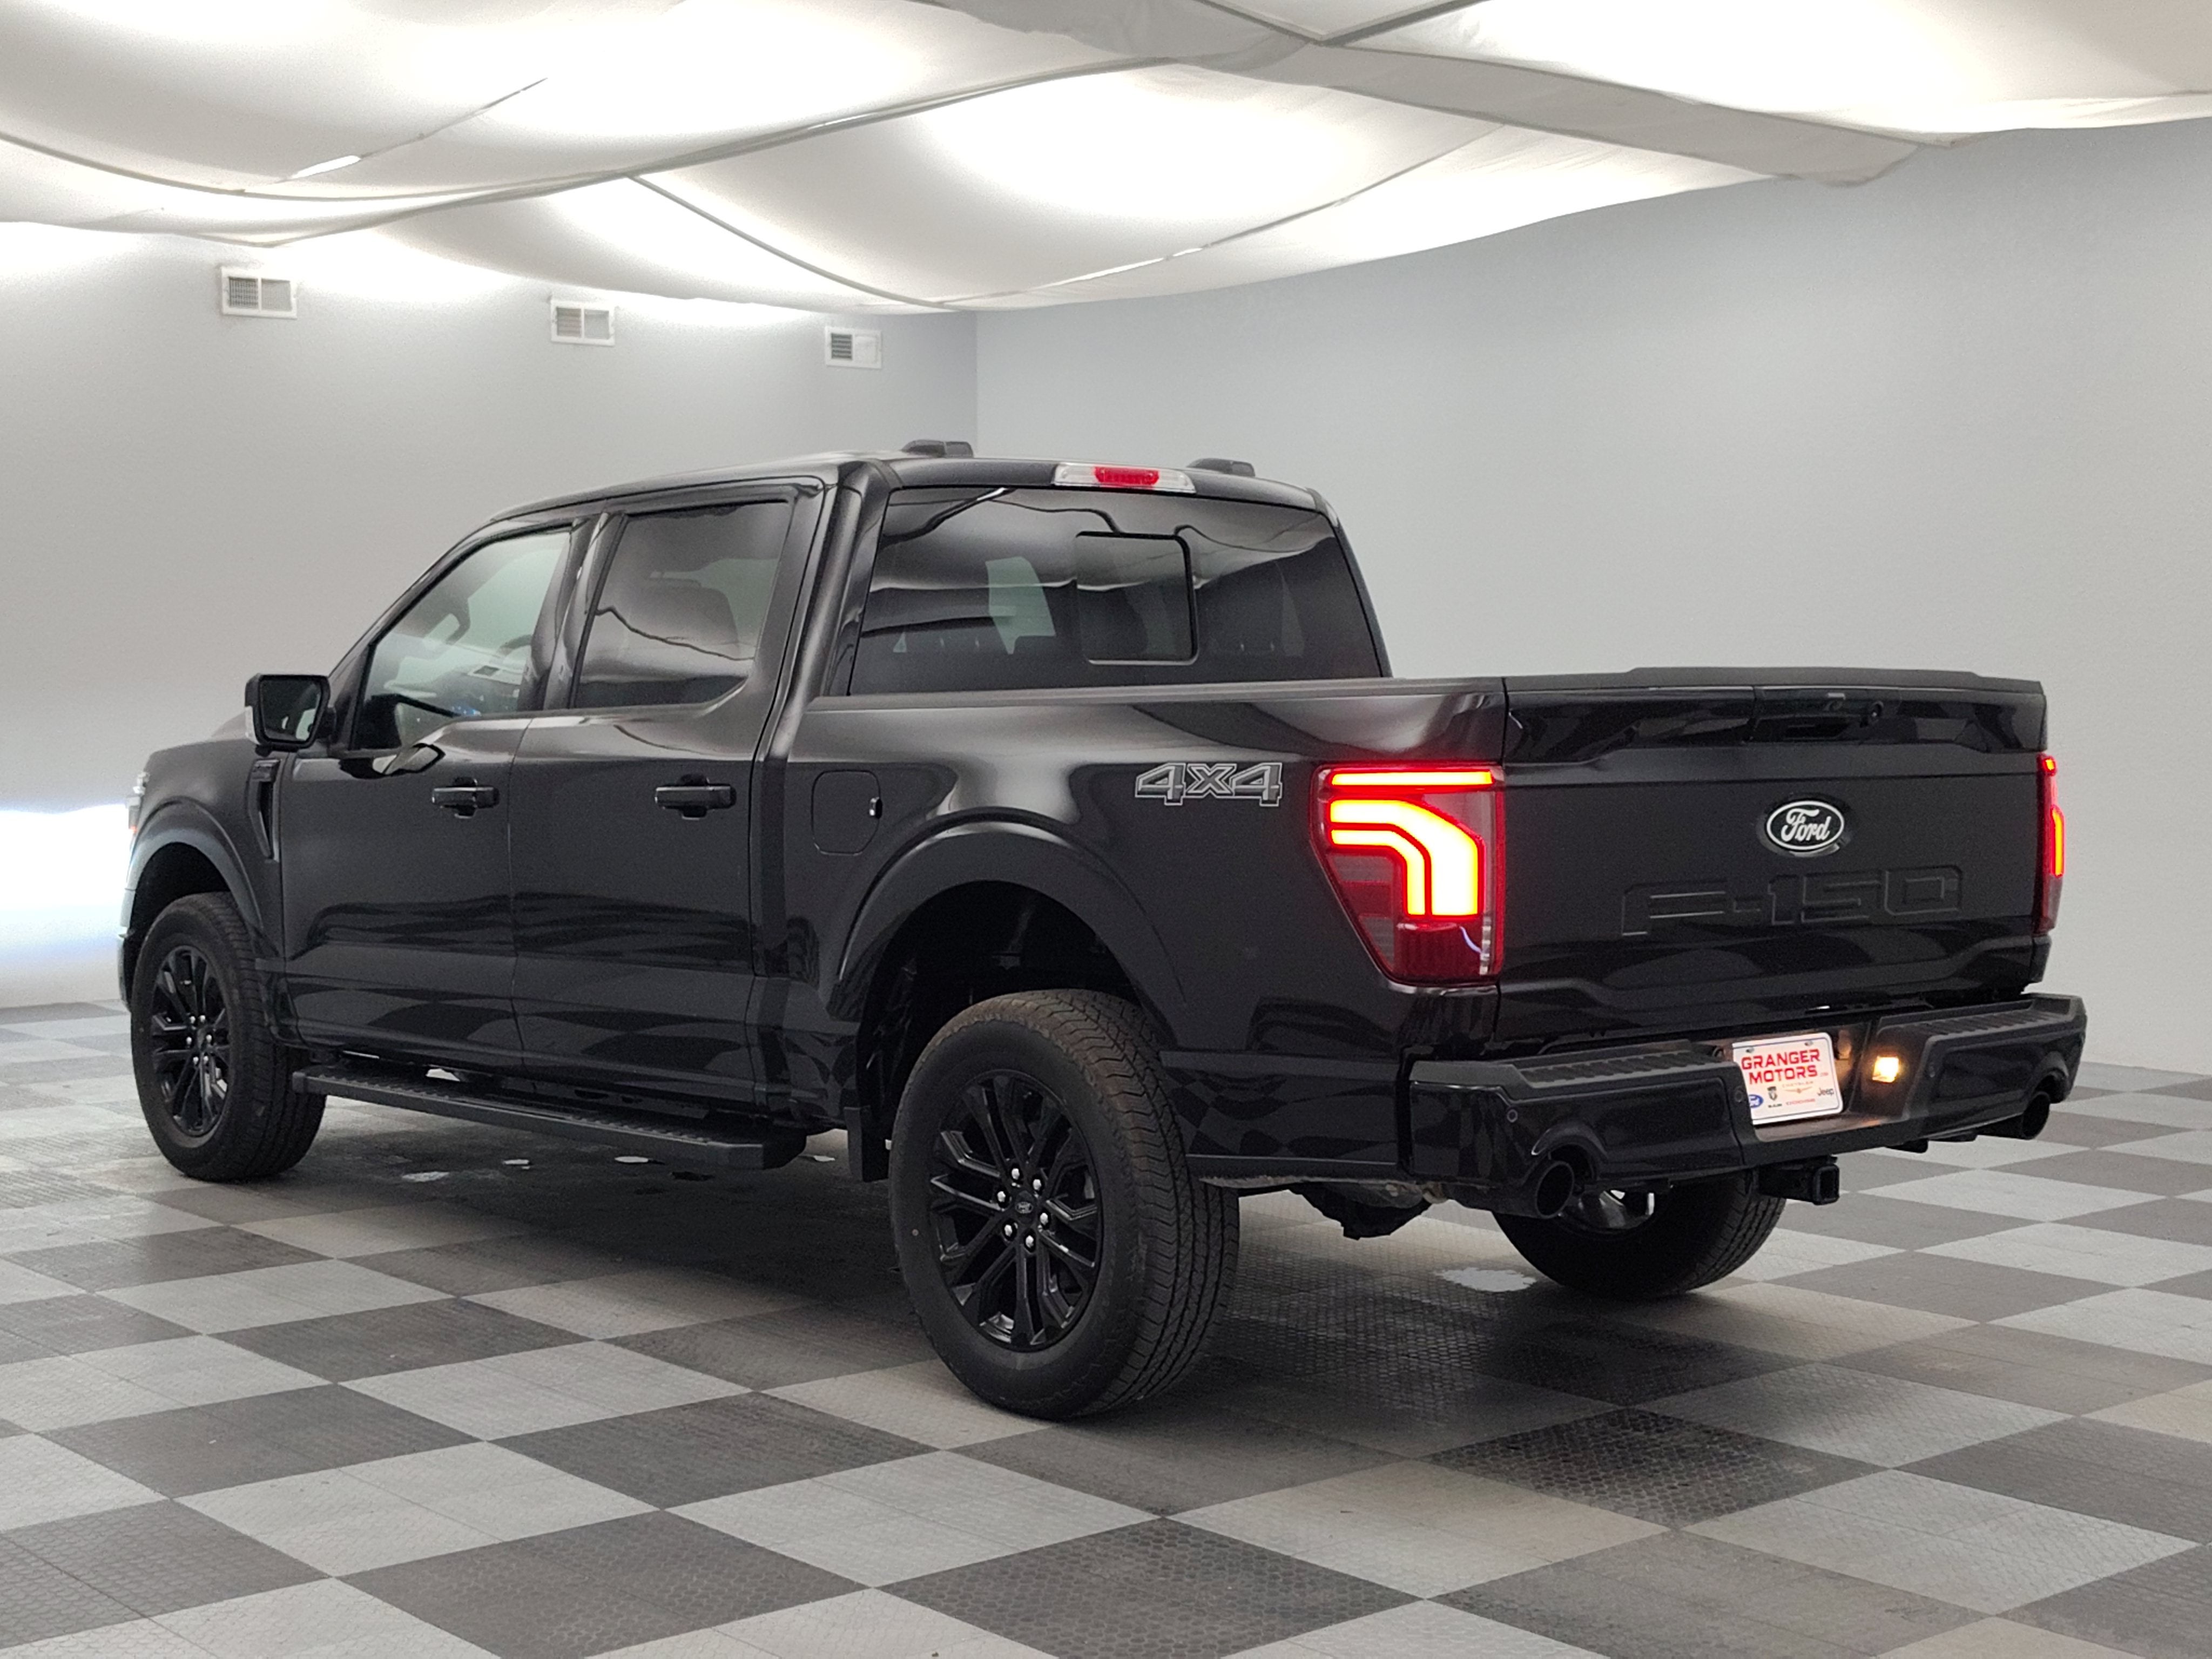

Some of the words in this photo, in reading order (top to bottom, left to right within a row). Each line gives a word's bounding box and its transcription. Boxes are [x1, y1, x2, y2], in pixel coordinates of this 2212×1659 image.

[1781, 808, 1832, 842] Ford
[1622, 865, 1963, 937] F-150
[1741, 1049, 1820, 1070] GRANGER
[1749, 1065, 1818, 1085] MOTORS
[1817, 1087, 1835, 1097] Jeep
